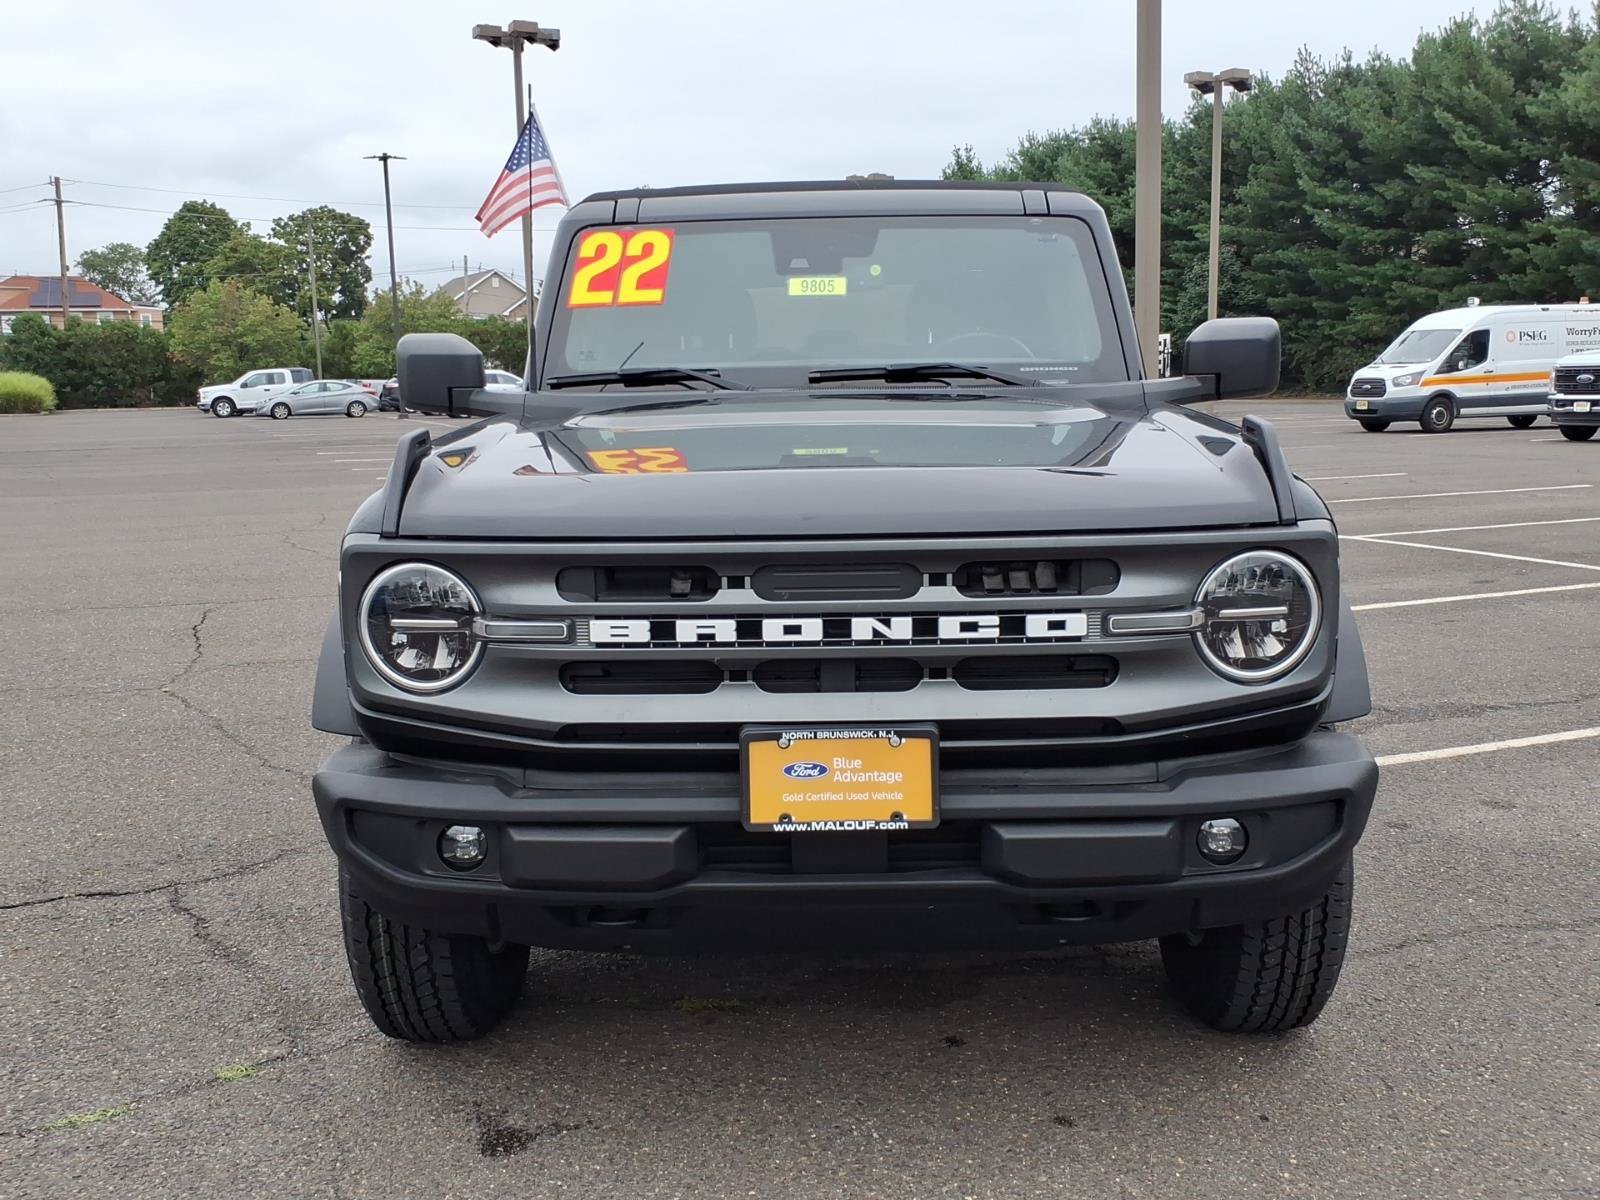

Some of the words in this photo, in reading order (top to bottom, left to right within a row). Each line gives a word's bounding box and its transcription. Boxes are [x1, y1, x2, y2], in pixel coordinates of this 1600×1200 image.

[568, 230, 671, 305] 22
[800, 279, 835, 293] 9805
[1519, 330, 1548, 342] PSEG
[589, 613, 1088, 642] BRONCO
[782, 731, 814, 740] NORTH
[833, 757, 862, 769] Blue
[790, 763, 821, 778] Ford
[833, 771, 903, 784] Advantage
[782, 792, 804, 802] Gold
[805, 791, 844, 801] Certified
[846, 791, 869, 801] Used
[871, 791, 904, 800] Vehicle
[773, 820, 909, 831] www.MALOUF.com
